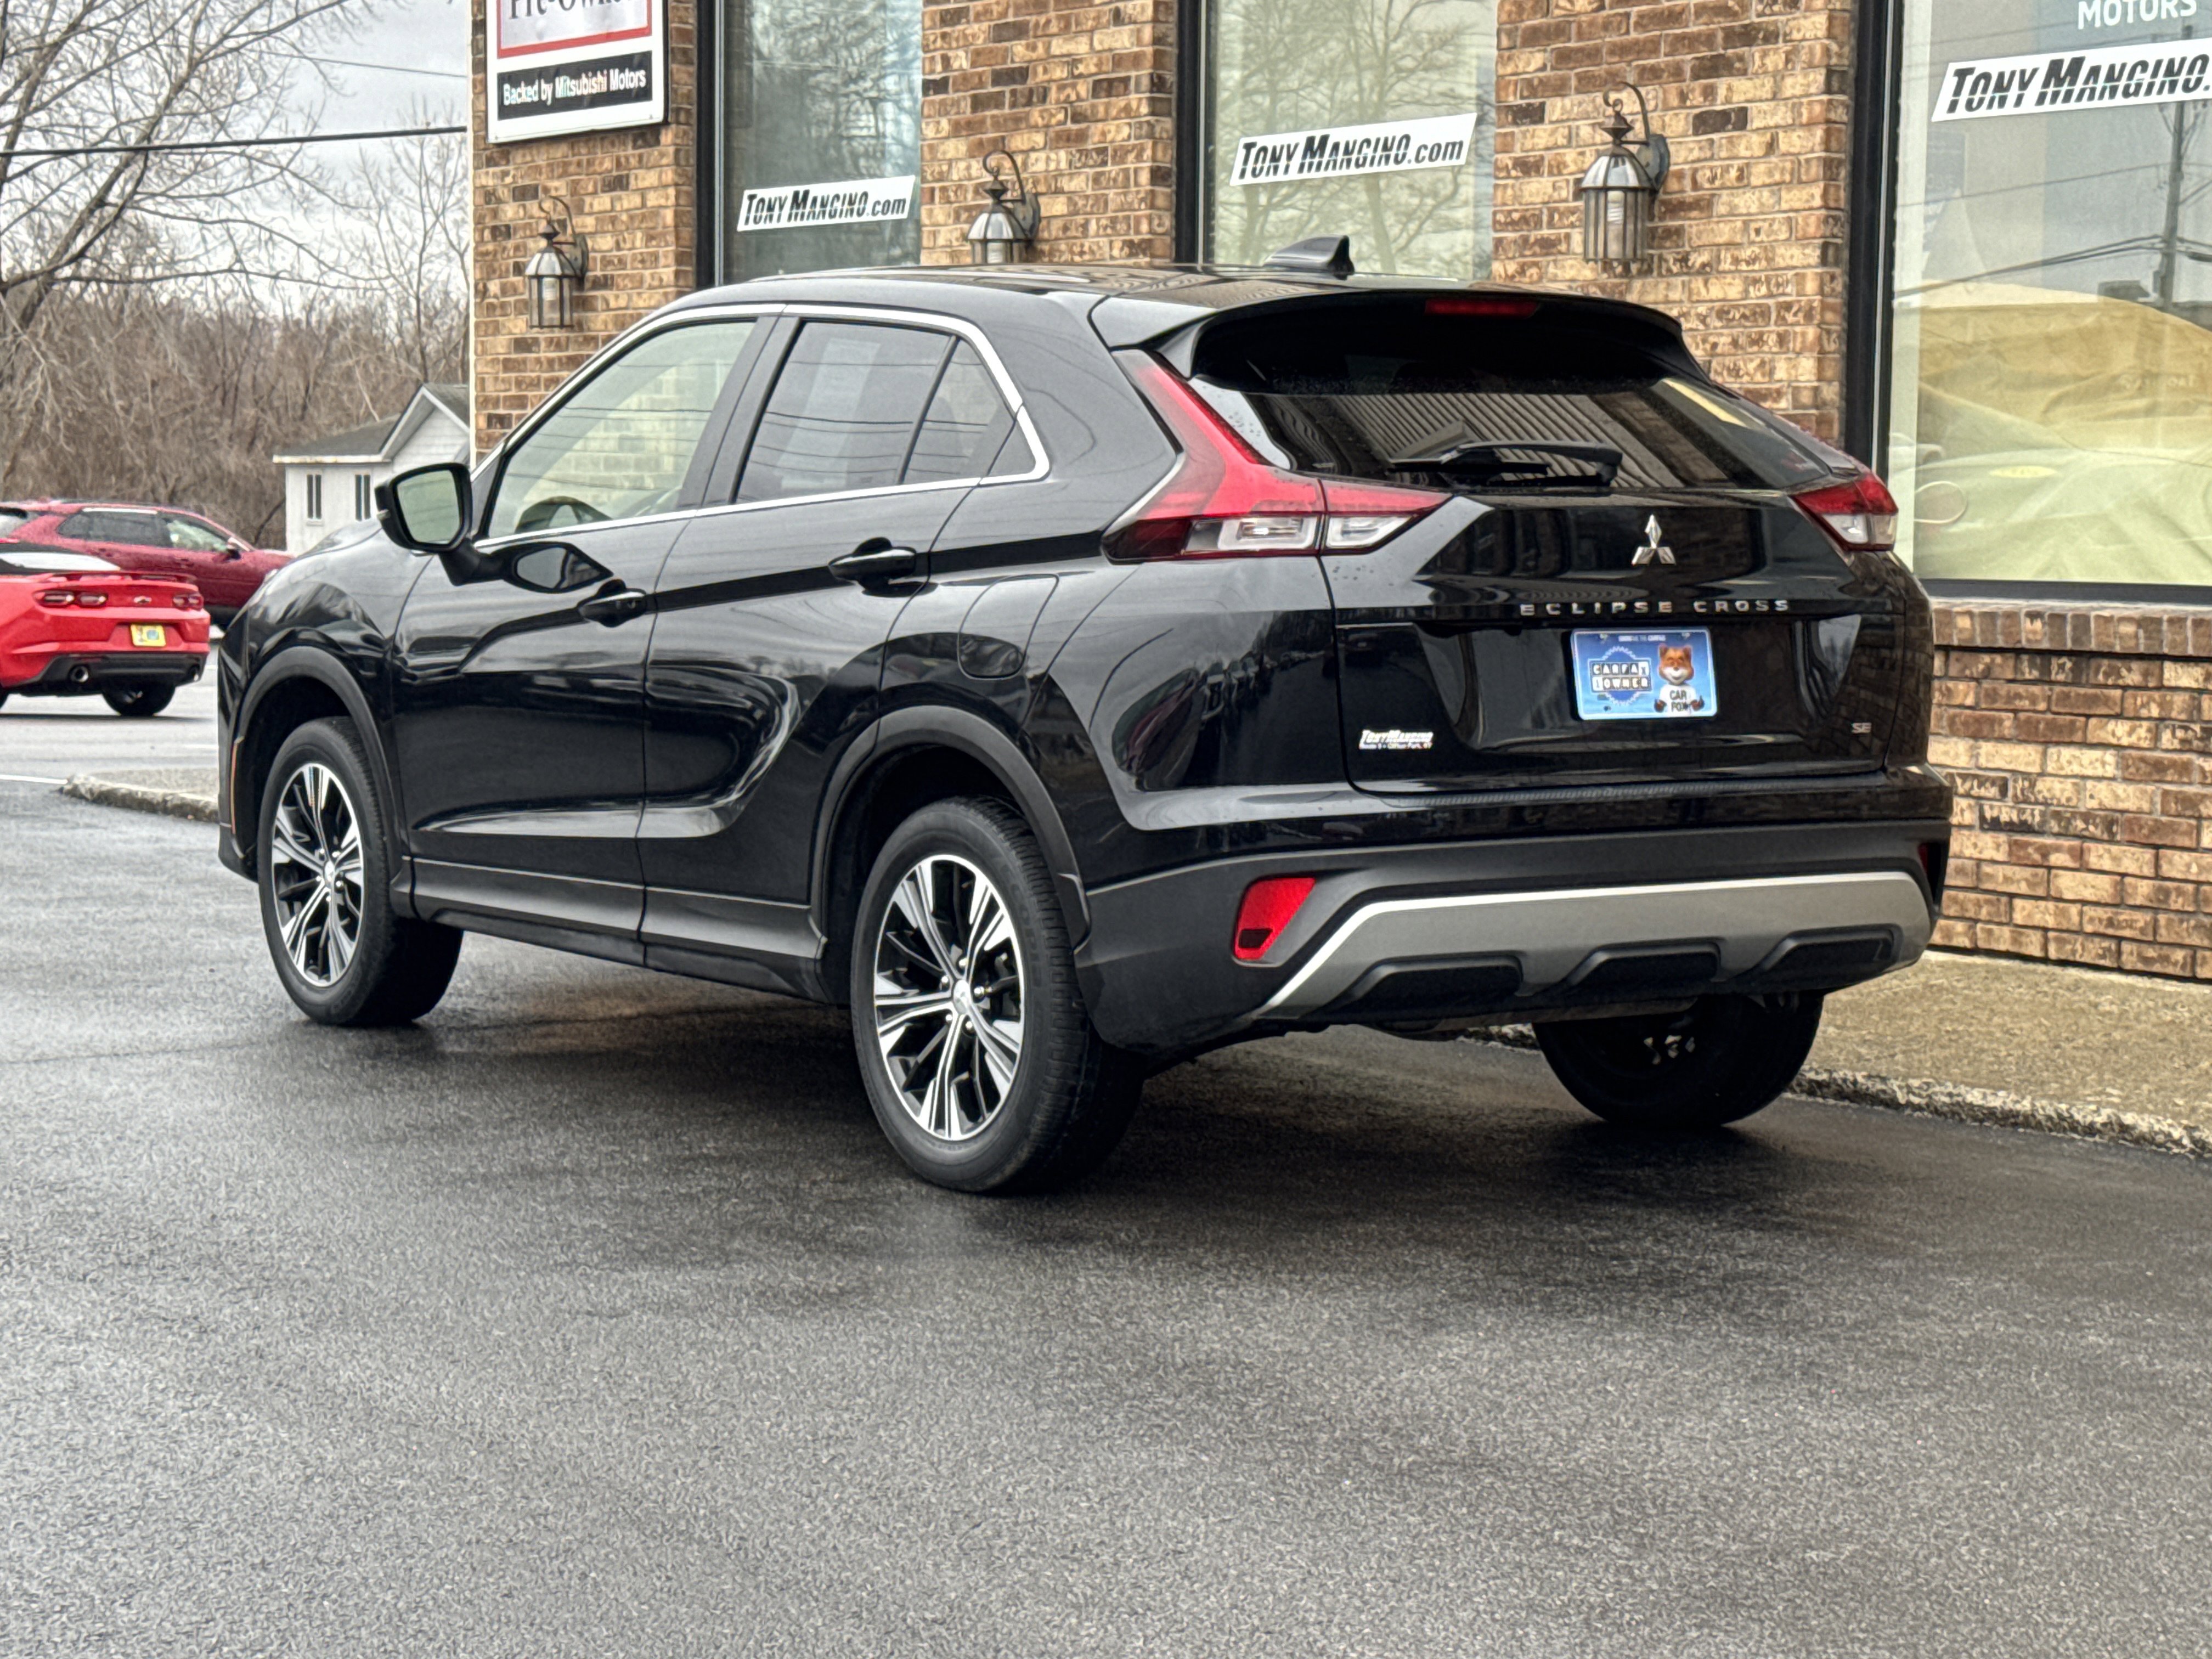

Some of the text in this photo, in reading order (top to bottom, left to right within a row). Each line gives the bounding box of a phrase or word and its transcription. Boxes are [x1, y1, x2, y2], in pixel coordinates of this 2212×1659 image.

[2078, 0, 2197, 30] MOTORS
[503, 67, 646, 106] Backed by Mitsubishi Motors
[1946, 66, 2040, 114] TONY
[1239, 141, 1300, 180] TONY
[744, 194, 788, 226] TONY
[1520, 600, 1788, 616] ECLIPSE CROSS
[1669, 690, 1687, 701] CAR
[1852, 722, 1872, 734] SE
